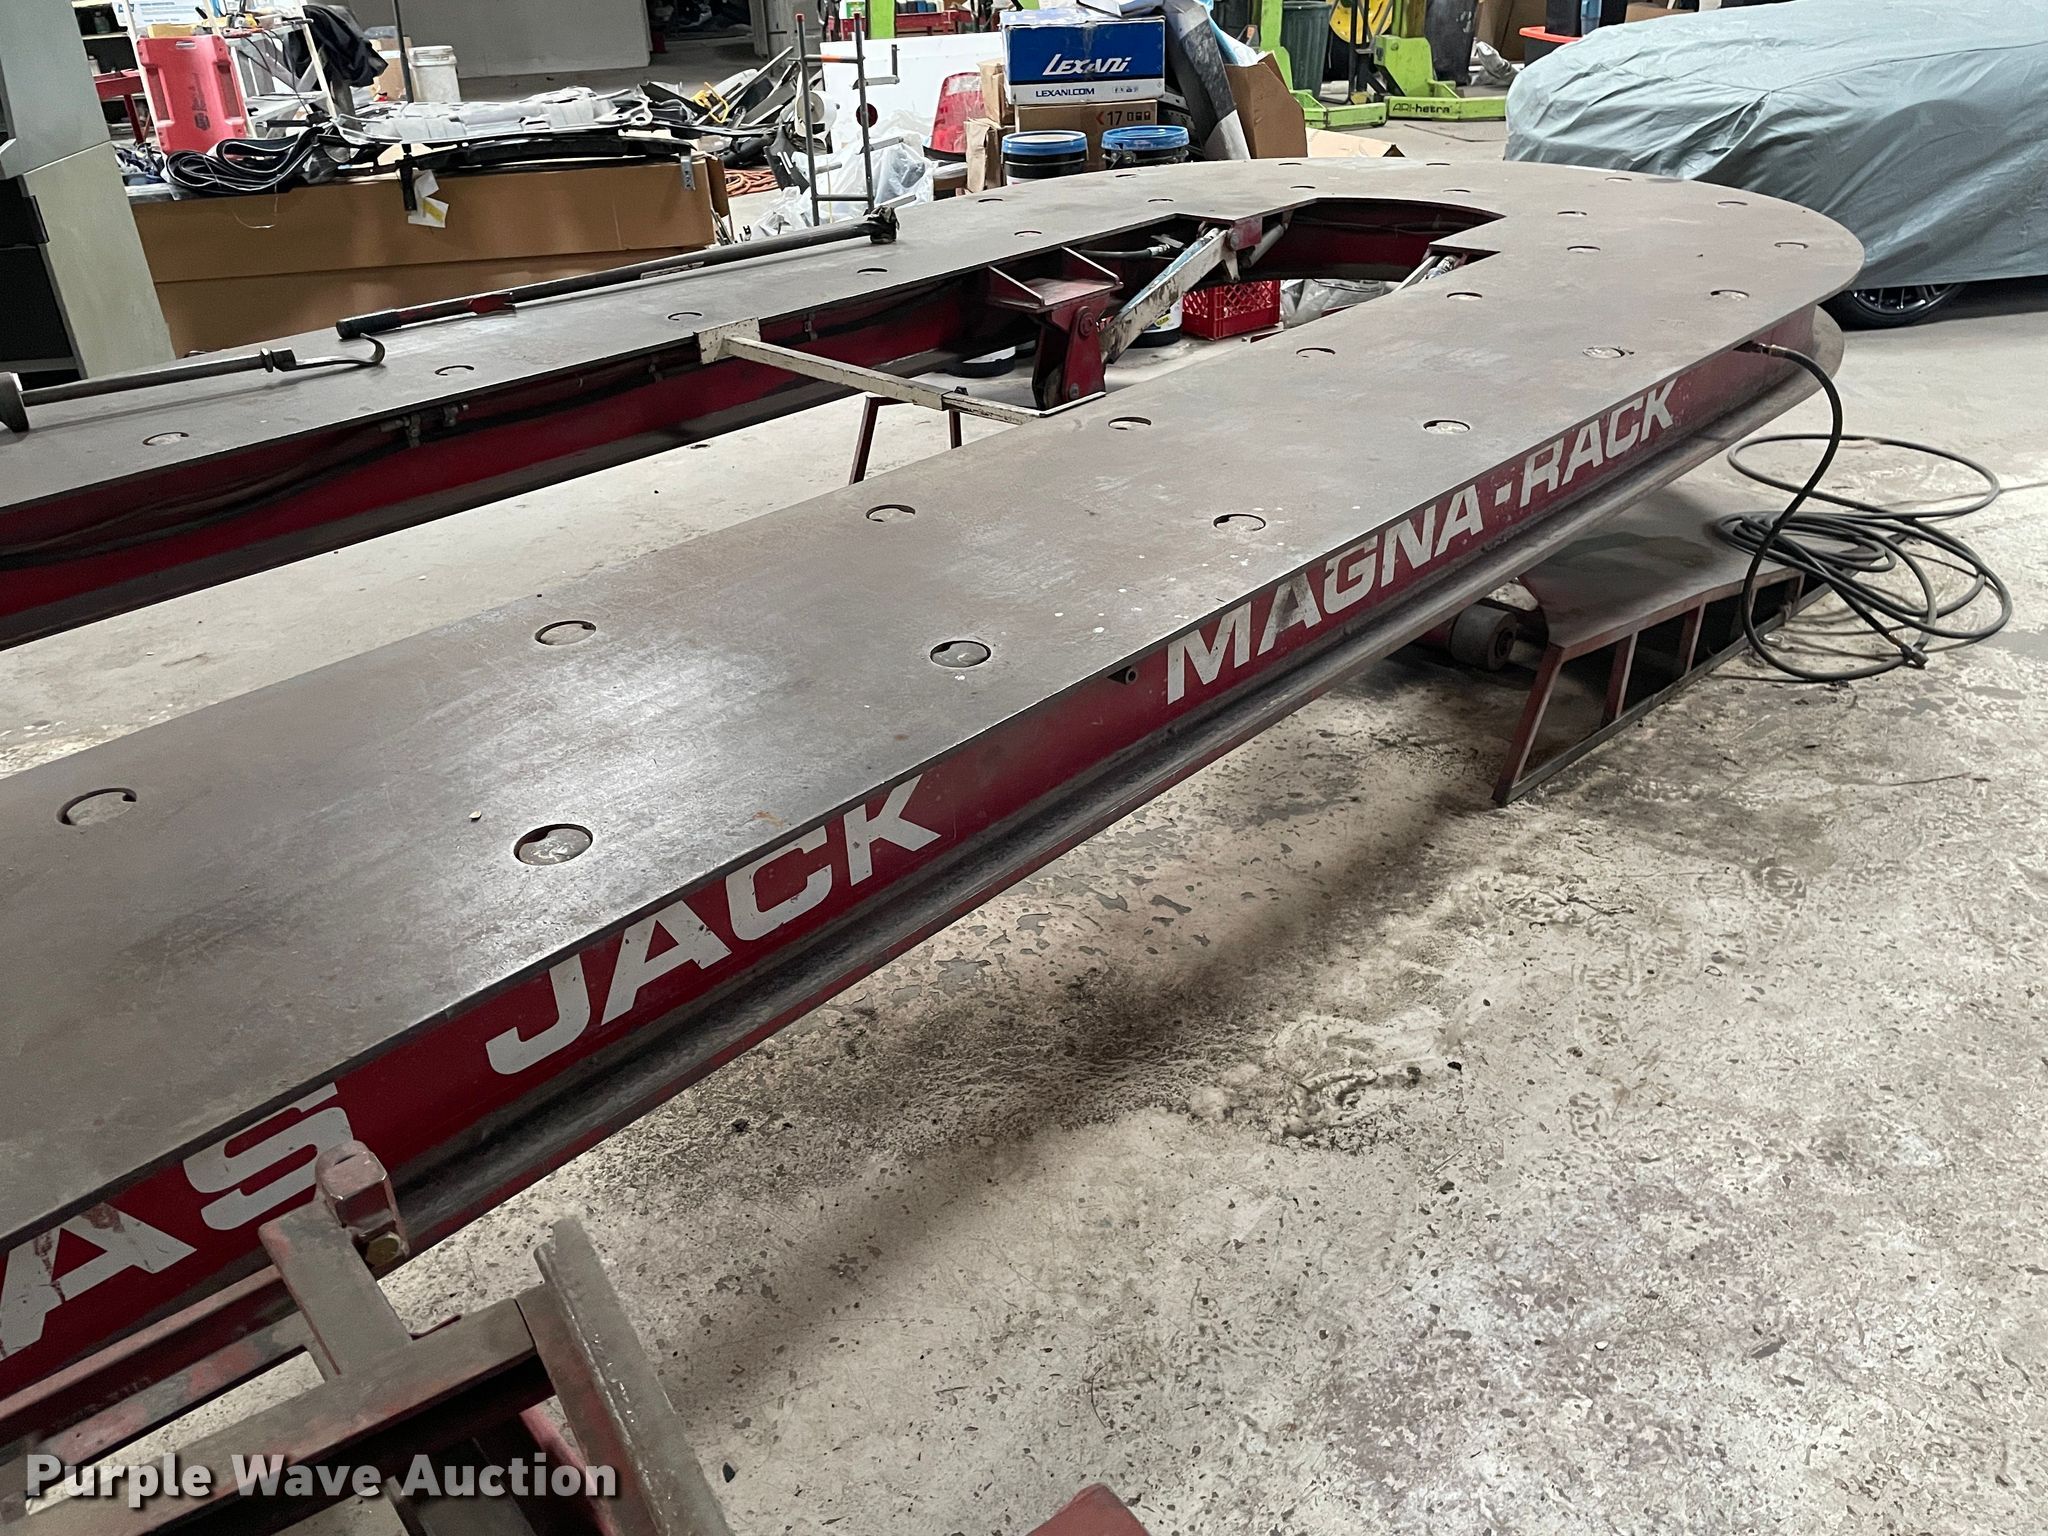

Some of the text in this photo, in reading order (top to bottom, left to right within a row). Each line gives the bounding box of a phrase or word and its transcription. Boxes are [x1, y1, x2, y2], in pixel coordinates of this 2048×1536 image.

[1035, 87, 1095, 98] LEXANI.COM
[485, 774, 942, 1075] JACK
[1166, 377, 1678, 705] MAGNA-RACK
